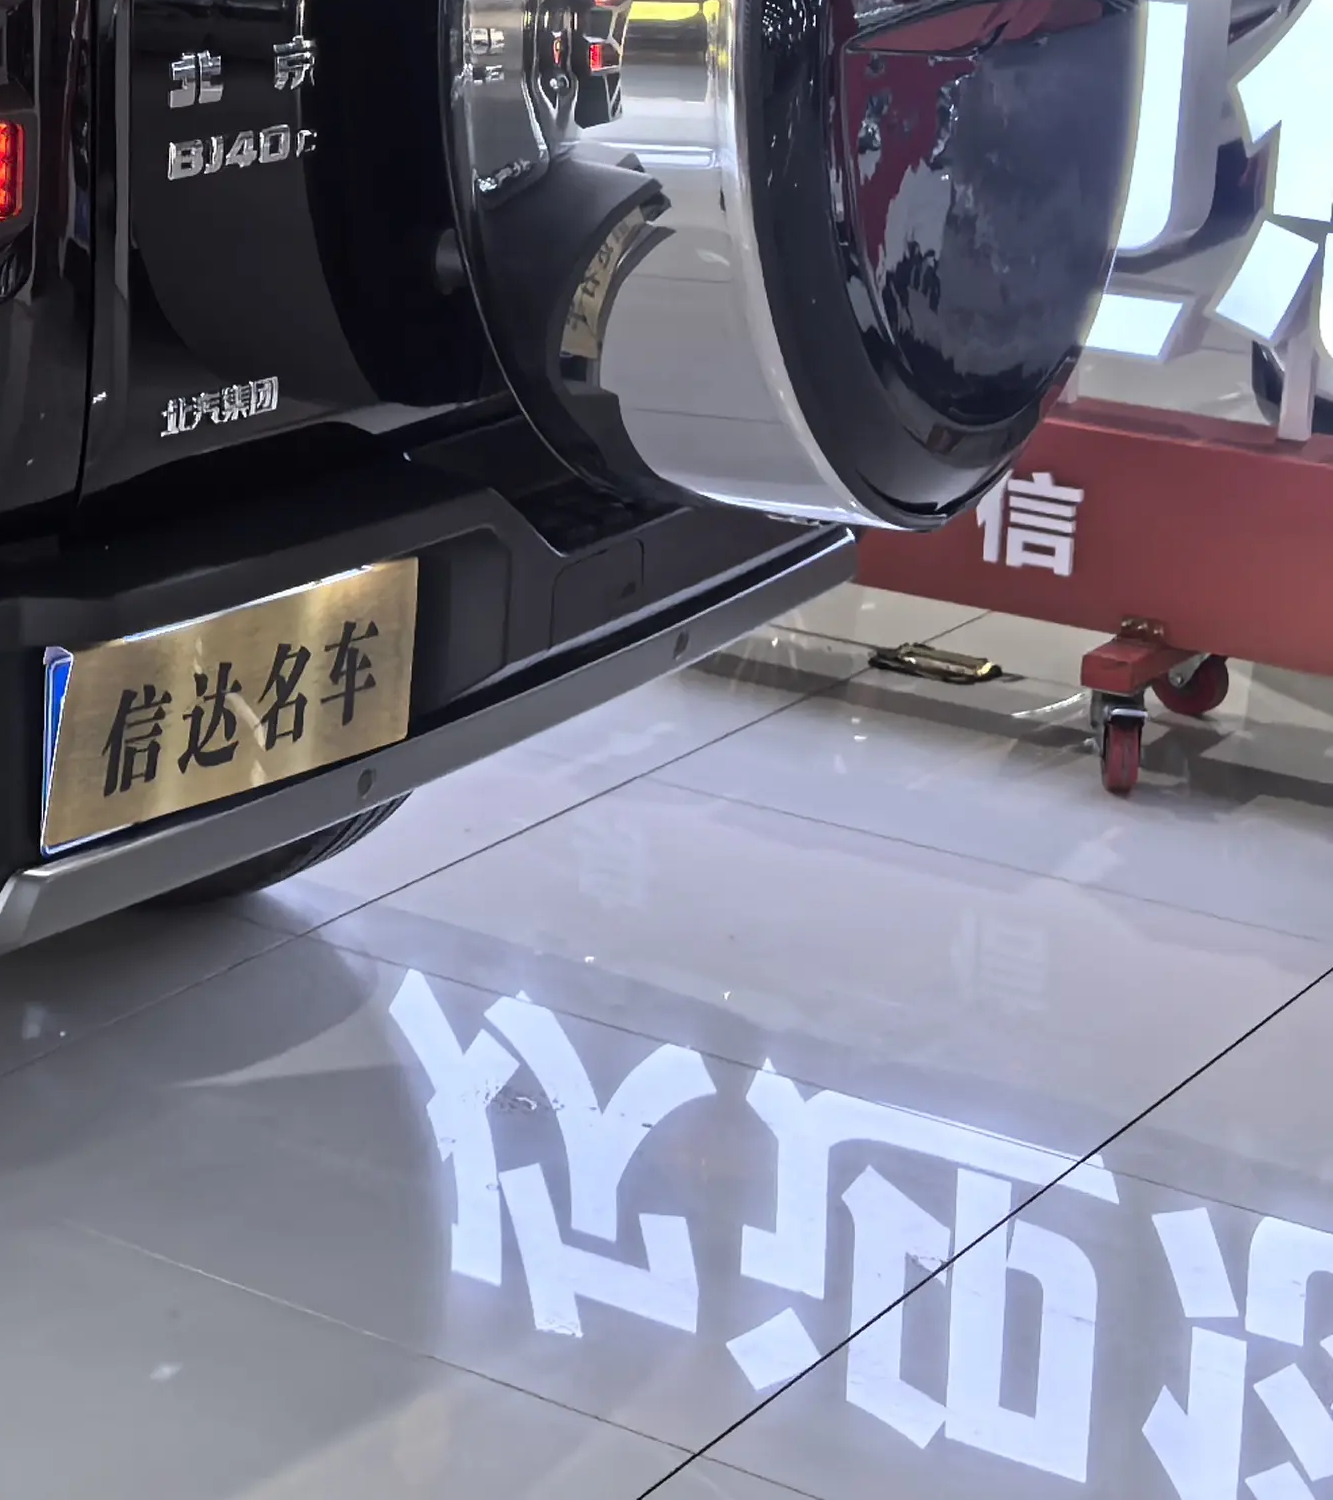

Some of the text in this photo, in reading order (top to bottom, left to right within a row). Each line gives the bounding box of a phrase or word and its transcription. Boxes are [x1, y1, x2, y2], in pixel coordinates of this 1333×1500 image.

[160, 377, 280, 438] 北汽集团
[977, 470, 1085, 578] 信
[100, 620, 379, 798] 信达名车
